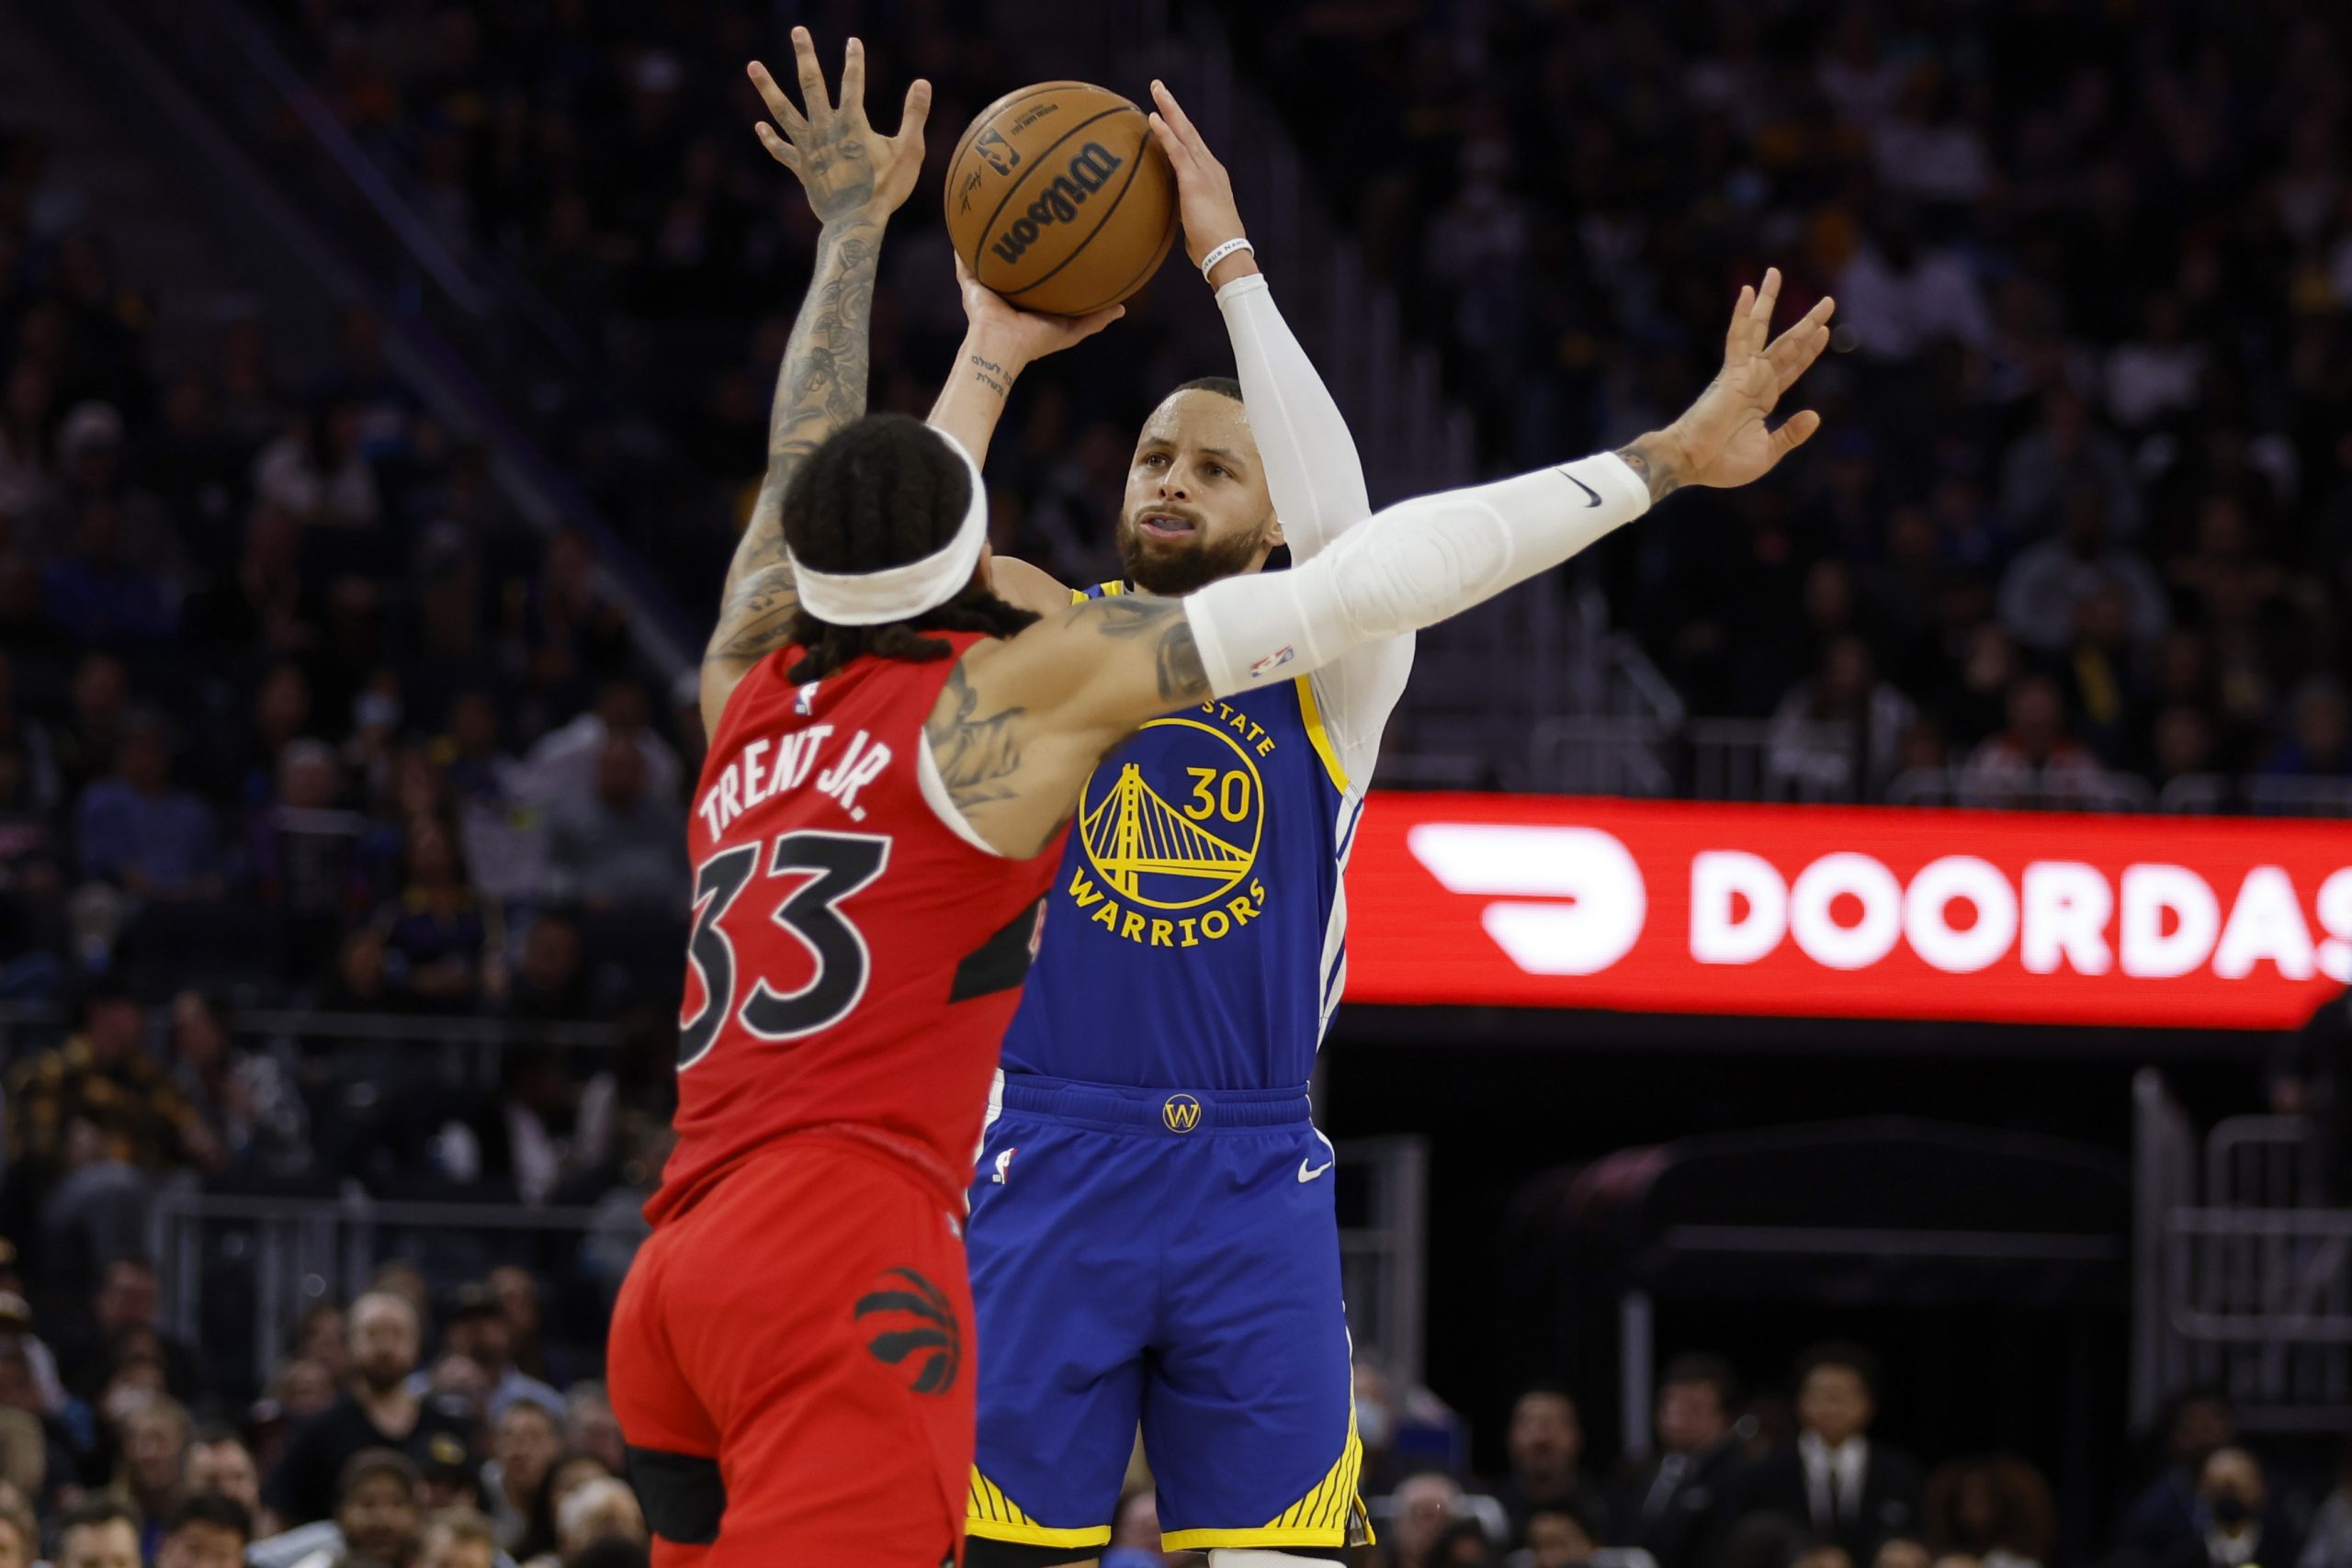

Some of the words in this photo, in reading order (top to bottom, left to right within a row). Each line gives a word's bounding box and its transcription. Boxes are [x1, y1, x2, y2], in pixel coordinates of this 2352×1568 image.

[990, 142, 1123, 265] Wilson
[1202, 699, 1276, 757] STATE
[698, 724, 834, 843] TRENT
[816, 728, 892, 823] JR.
[1183, 766, 1250, 823] 30
[1069, 866, 1266, 947] WARRIORS
[676, 829, 893, 1072] 33
[1165, 1103, 1200, 1129] W
